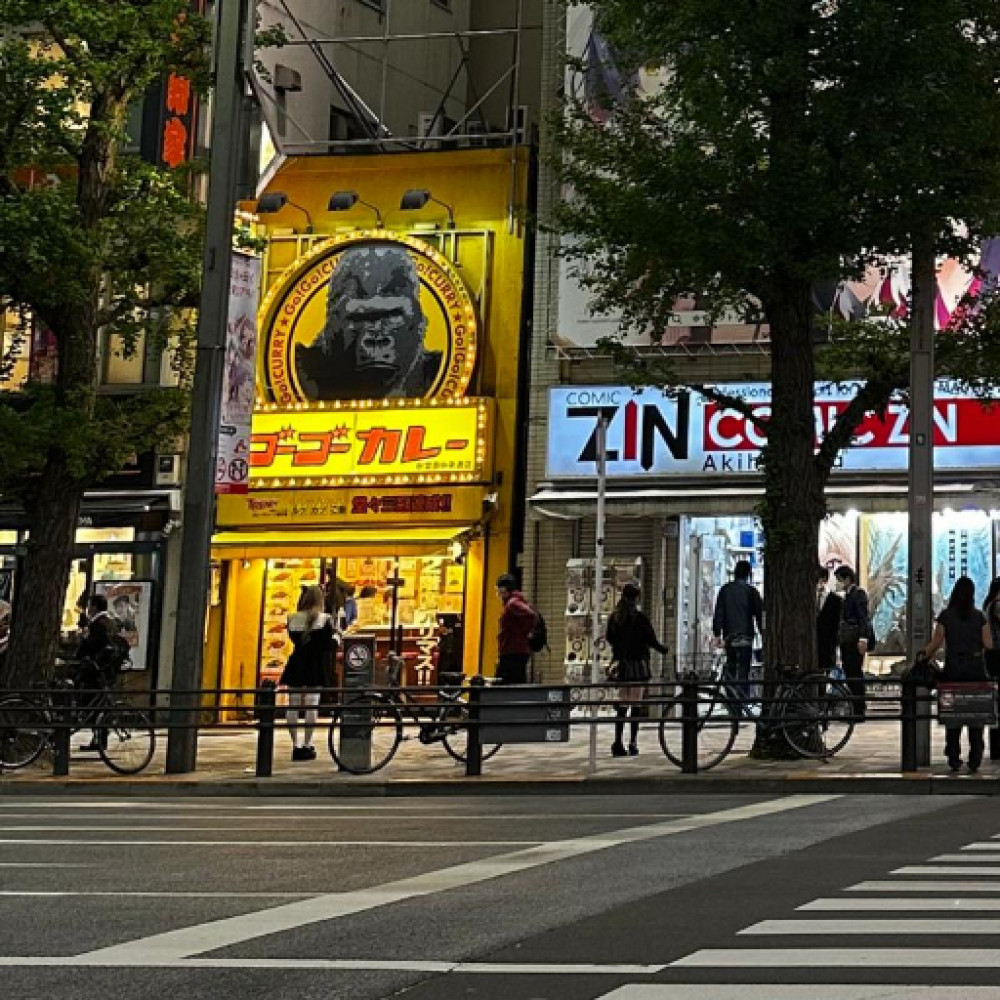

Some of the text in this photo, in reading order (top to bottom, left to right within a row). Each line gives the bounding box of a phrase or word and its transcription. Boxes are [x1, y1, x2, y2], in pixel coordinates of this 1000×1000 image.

[566, 391, 622, 406] COMIC
[249, 422, 470, 468] ゴーゴーカレー
[566, 388, 691, 472] ZIN
